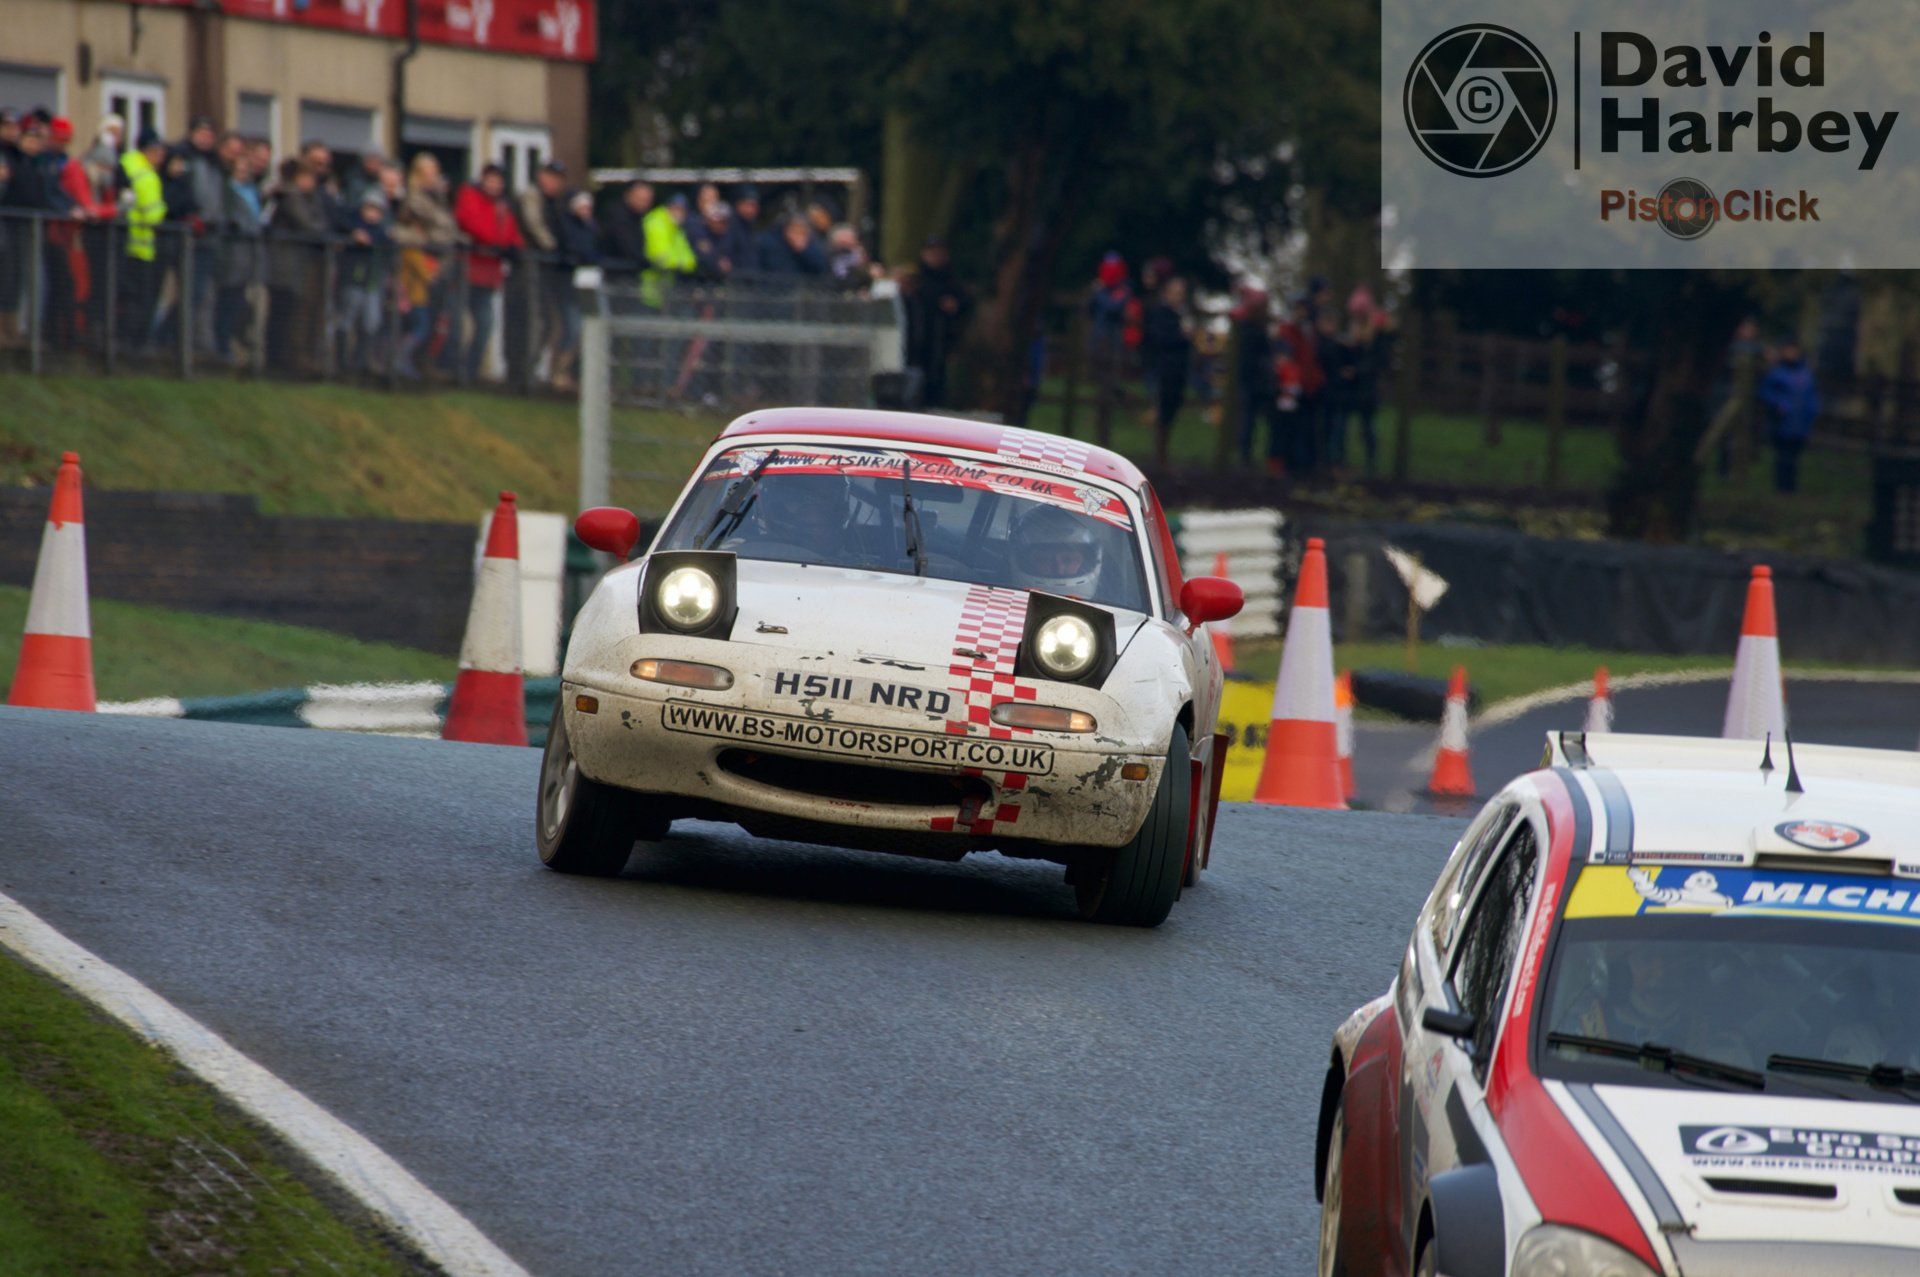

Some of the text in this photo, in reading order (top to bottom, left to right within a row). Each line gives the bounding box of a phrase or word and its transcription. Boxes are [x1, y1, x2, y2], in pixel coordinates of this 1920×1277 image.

[771, 453, 1058, 496] WWW.MSNRALYCHAMP.CO.UK
[774, 671, 951, 715] H511 NRD
[670, 704, 1046, 769] WWW.BS-MOTORSPORT.CO.UK
[1742, 880, 1920, 914] MICH
[1769, 1127, 1862, 1146] Euro
[1806, 1141, 1920, 1164] Comp
